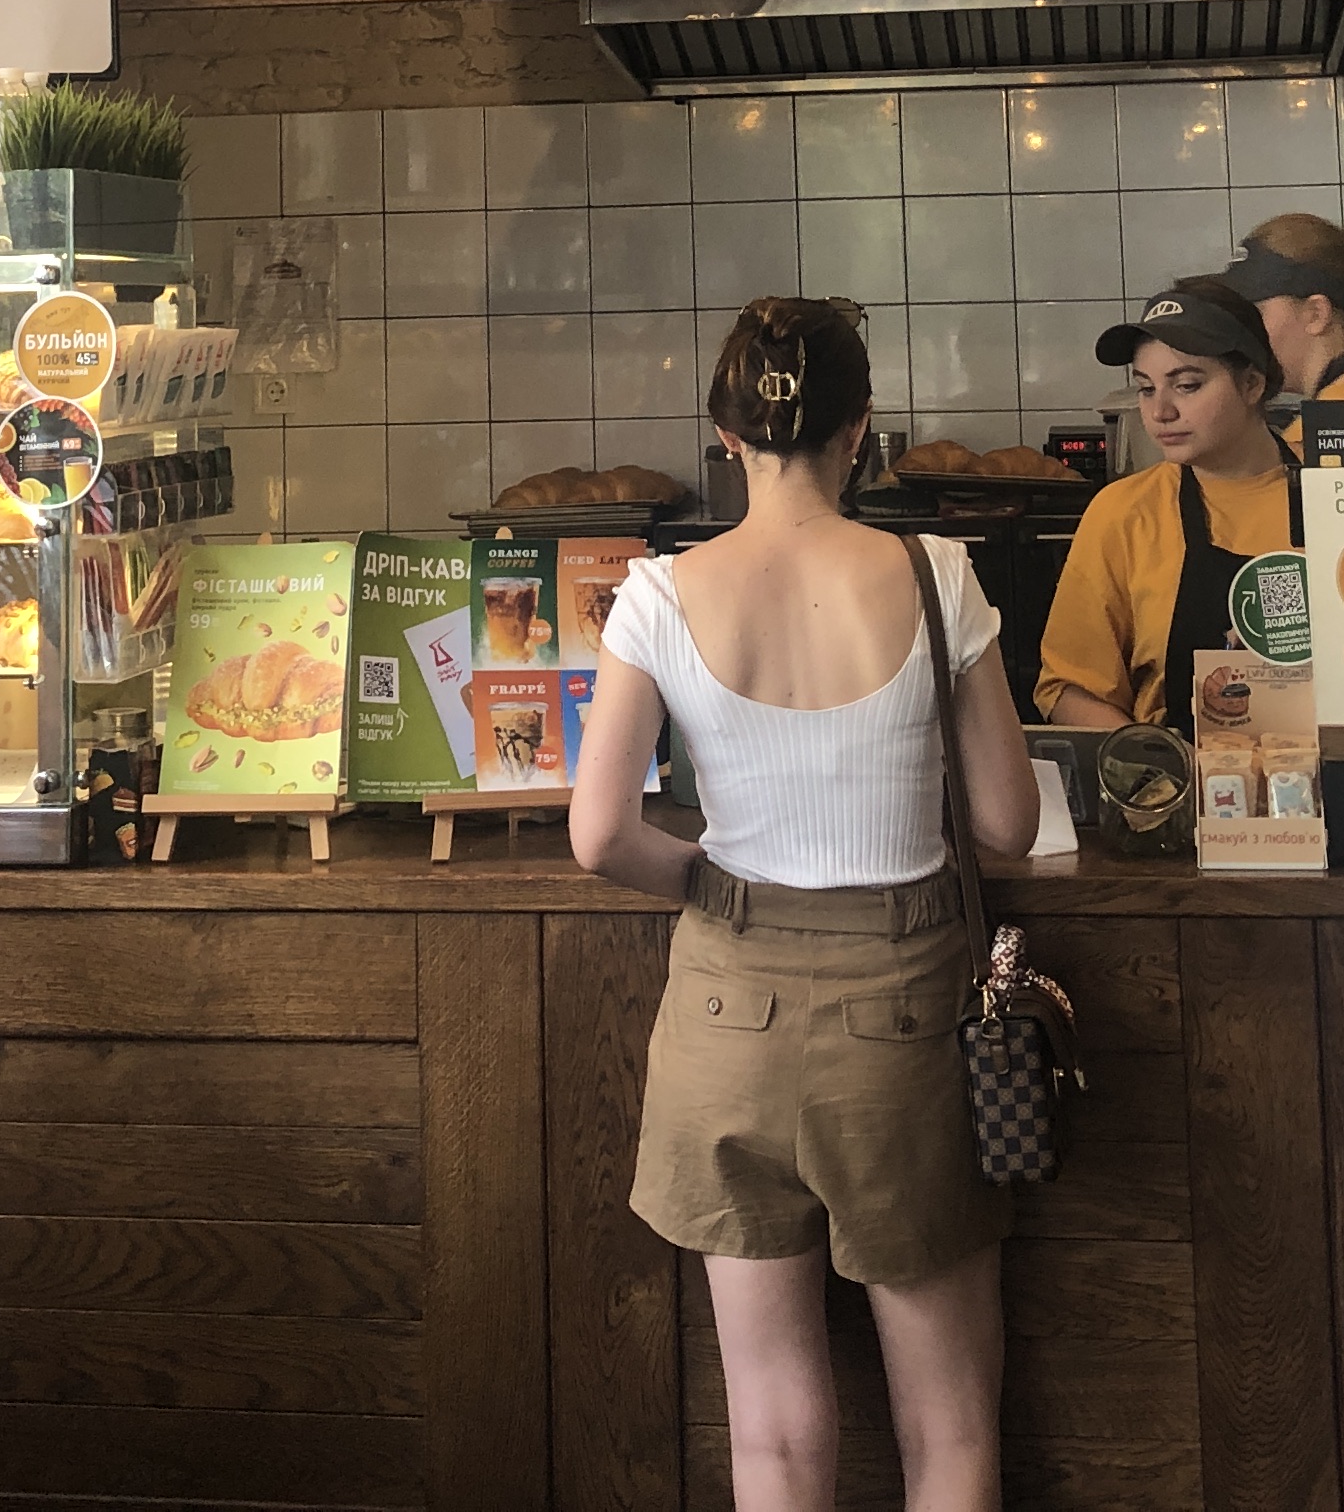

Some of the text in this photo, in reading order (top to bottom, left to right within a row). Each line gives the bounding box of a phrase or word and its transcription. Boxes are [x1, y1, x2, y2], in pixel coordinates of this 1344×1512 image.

[25, 329, 108, 350] БУЛЬЙОН
[37, 352, 91, 365] 100% 45
[19, 432, 37, 443] ЧАЙ
[63, 439, 75, 449] 49
[488, 549, 539, 558] ORANGE
[563, 555, 636, 565] ICED LATT
[487, 558, 536, 569] COFFEE
[193, 574, 325, 594] ФІСТАШКВИЙ
[362, 583, 446, 607] ЗА ВІДГУК
[190, 613, 211, 629] 99
[1264, 614, 1308, 629] ДОДАТОК
[489, 682, 546, 695] FRAPPÉ
[568, 682, 587, 692] NEW
[358, 712, 394, 727] ЗАЛИШ
[358, 727, 394, 741] ВІДГУК
[1202, 832, 1249, 847] смакуй
[1253, 833, 1259, 844] з
